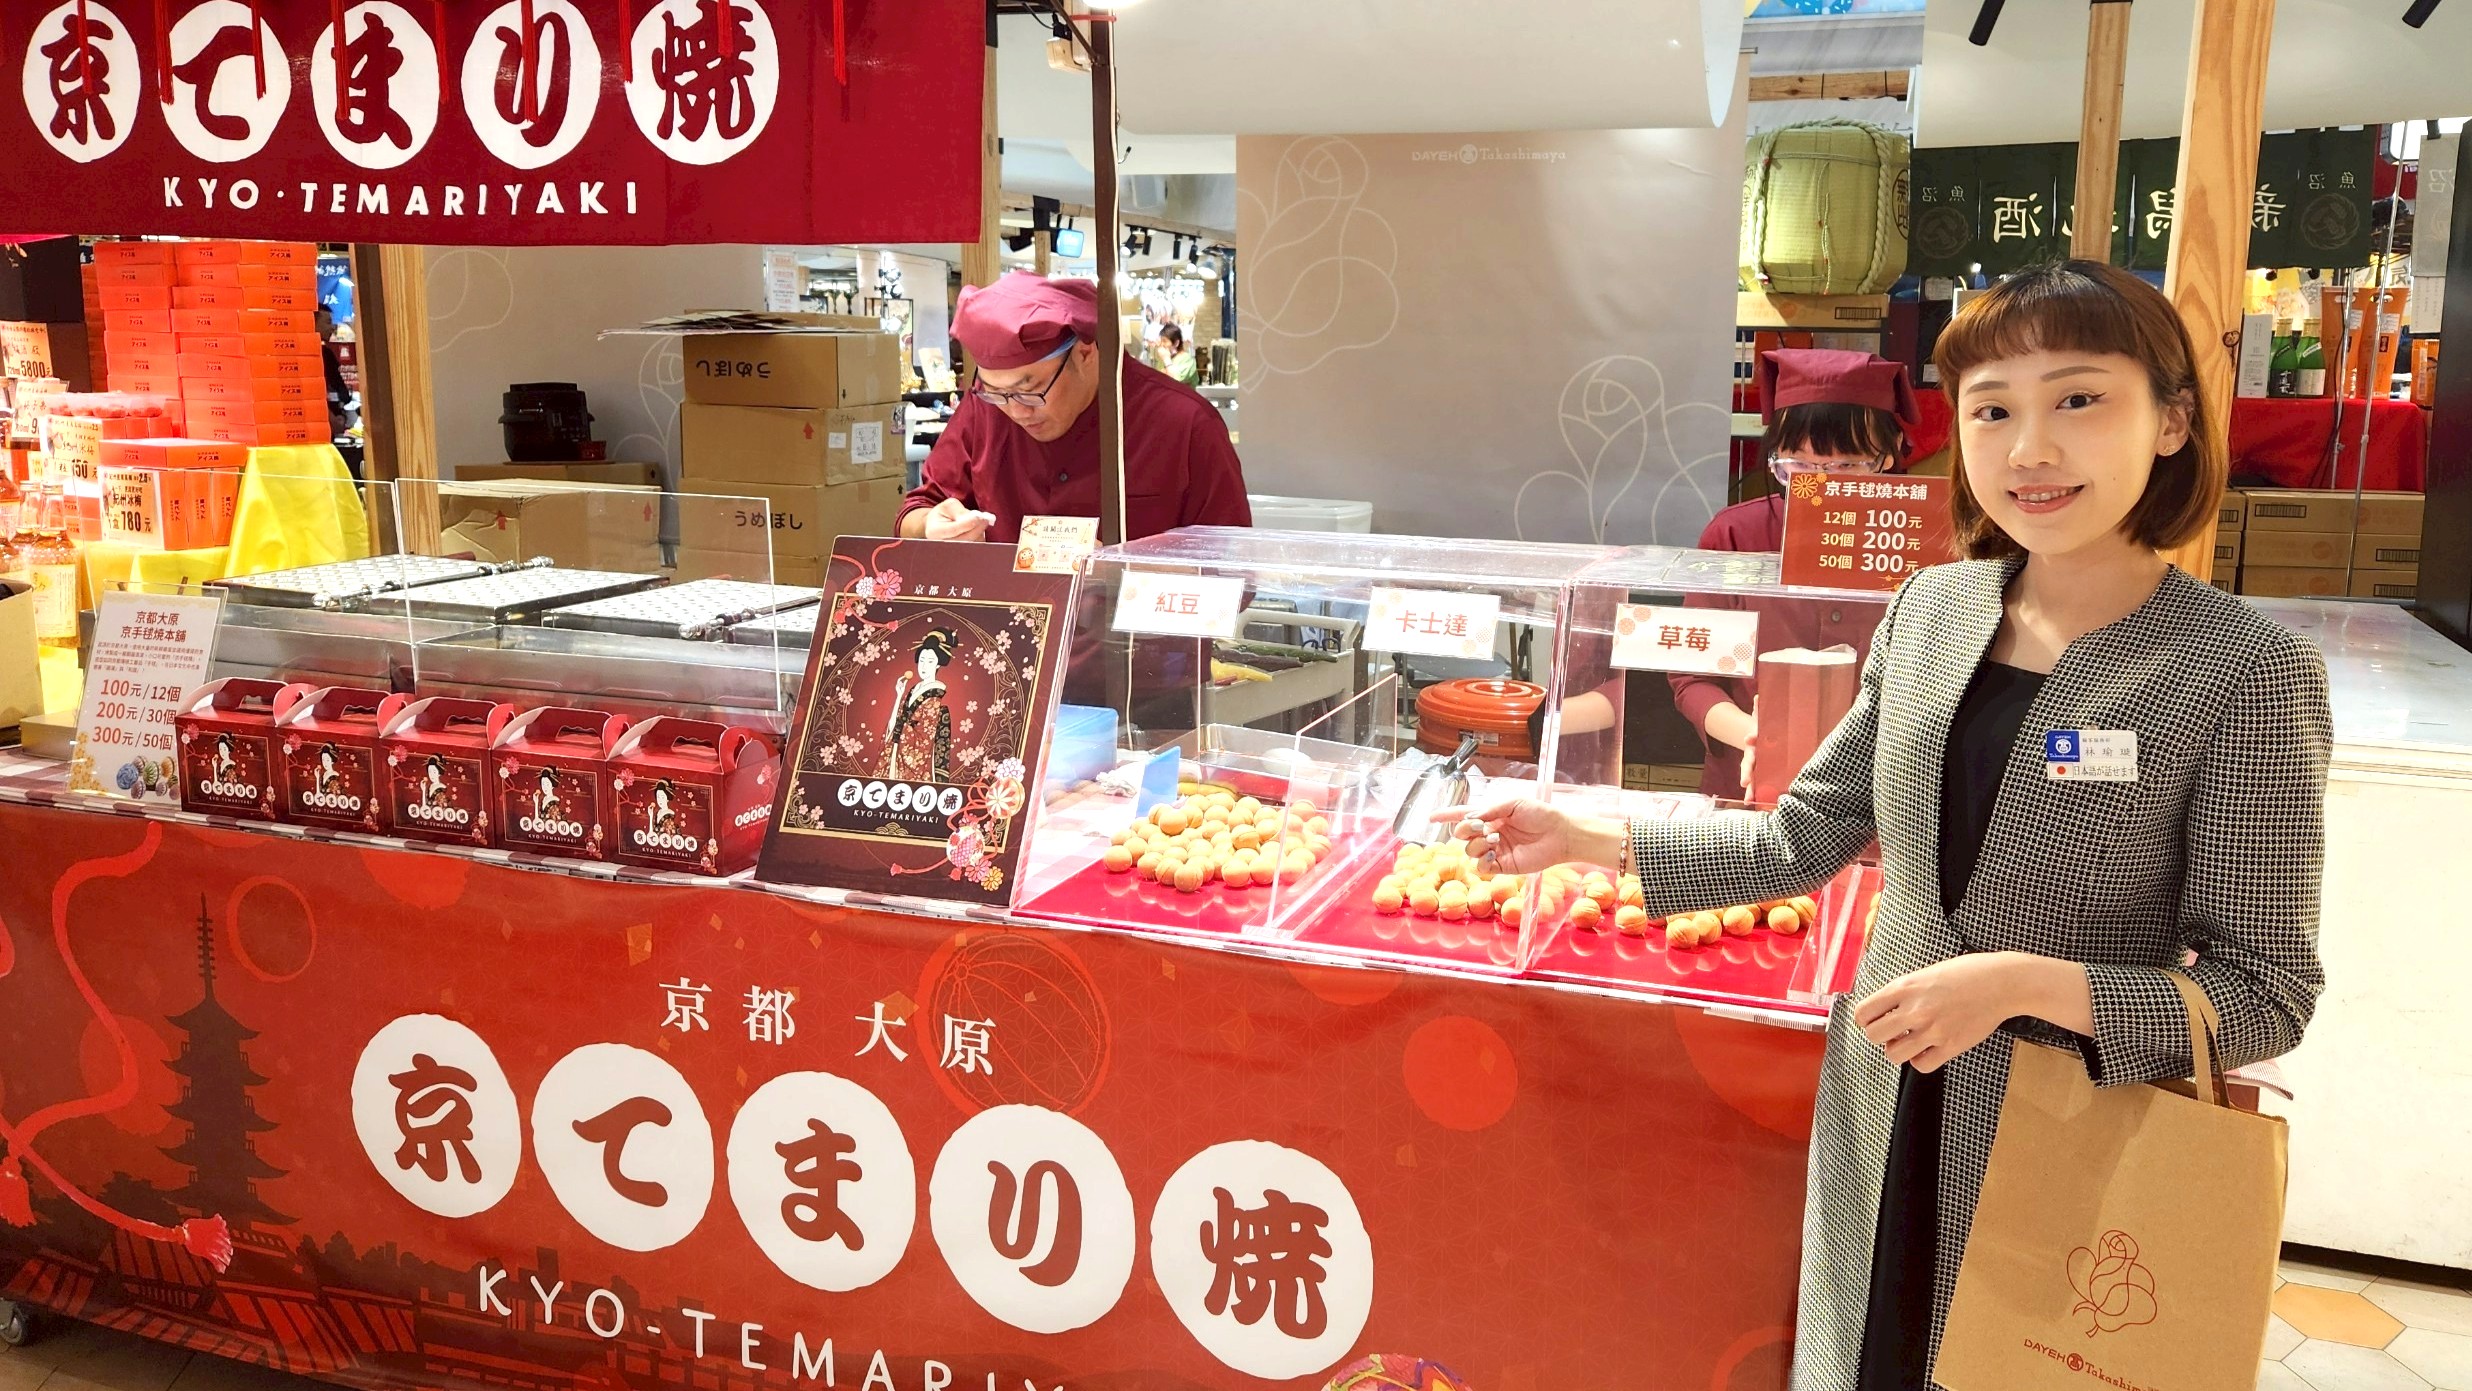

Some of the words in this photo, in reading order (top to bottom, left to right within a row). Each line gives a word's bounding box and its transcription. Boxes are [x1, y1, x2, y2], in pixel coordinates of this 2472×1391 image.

[42, 0, 757, 150] 京てまり焼
[1411, 150, 1459, 162] DAYEH
[1479, 146, 1567, 164] Takashimaya
[734, 510, 804, 530] うめぼし
[1823, 510, 1857, 526] 12個
[1820, 532, 1855, 548] 30個
[1818, 554, 1853, 570] 50個
[1154, 591, 1201, 616] 紅豆
[135, 611, 180, 626] 京都大原
[1395, 610, 1469, 638] 卡士達
[1657, 624, 1712, 653] 草莓
[387, 1052, 1332, 1340] 京てまり焼
[2023, 1338, 2066, 1363] DAYEH
